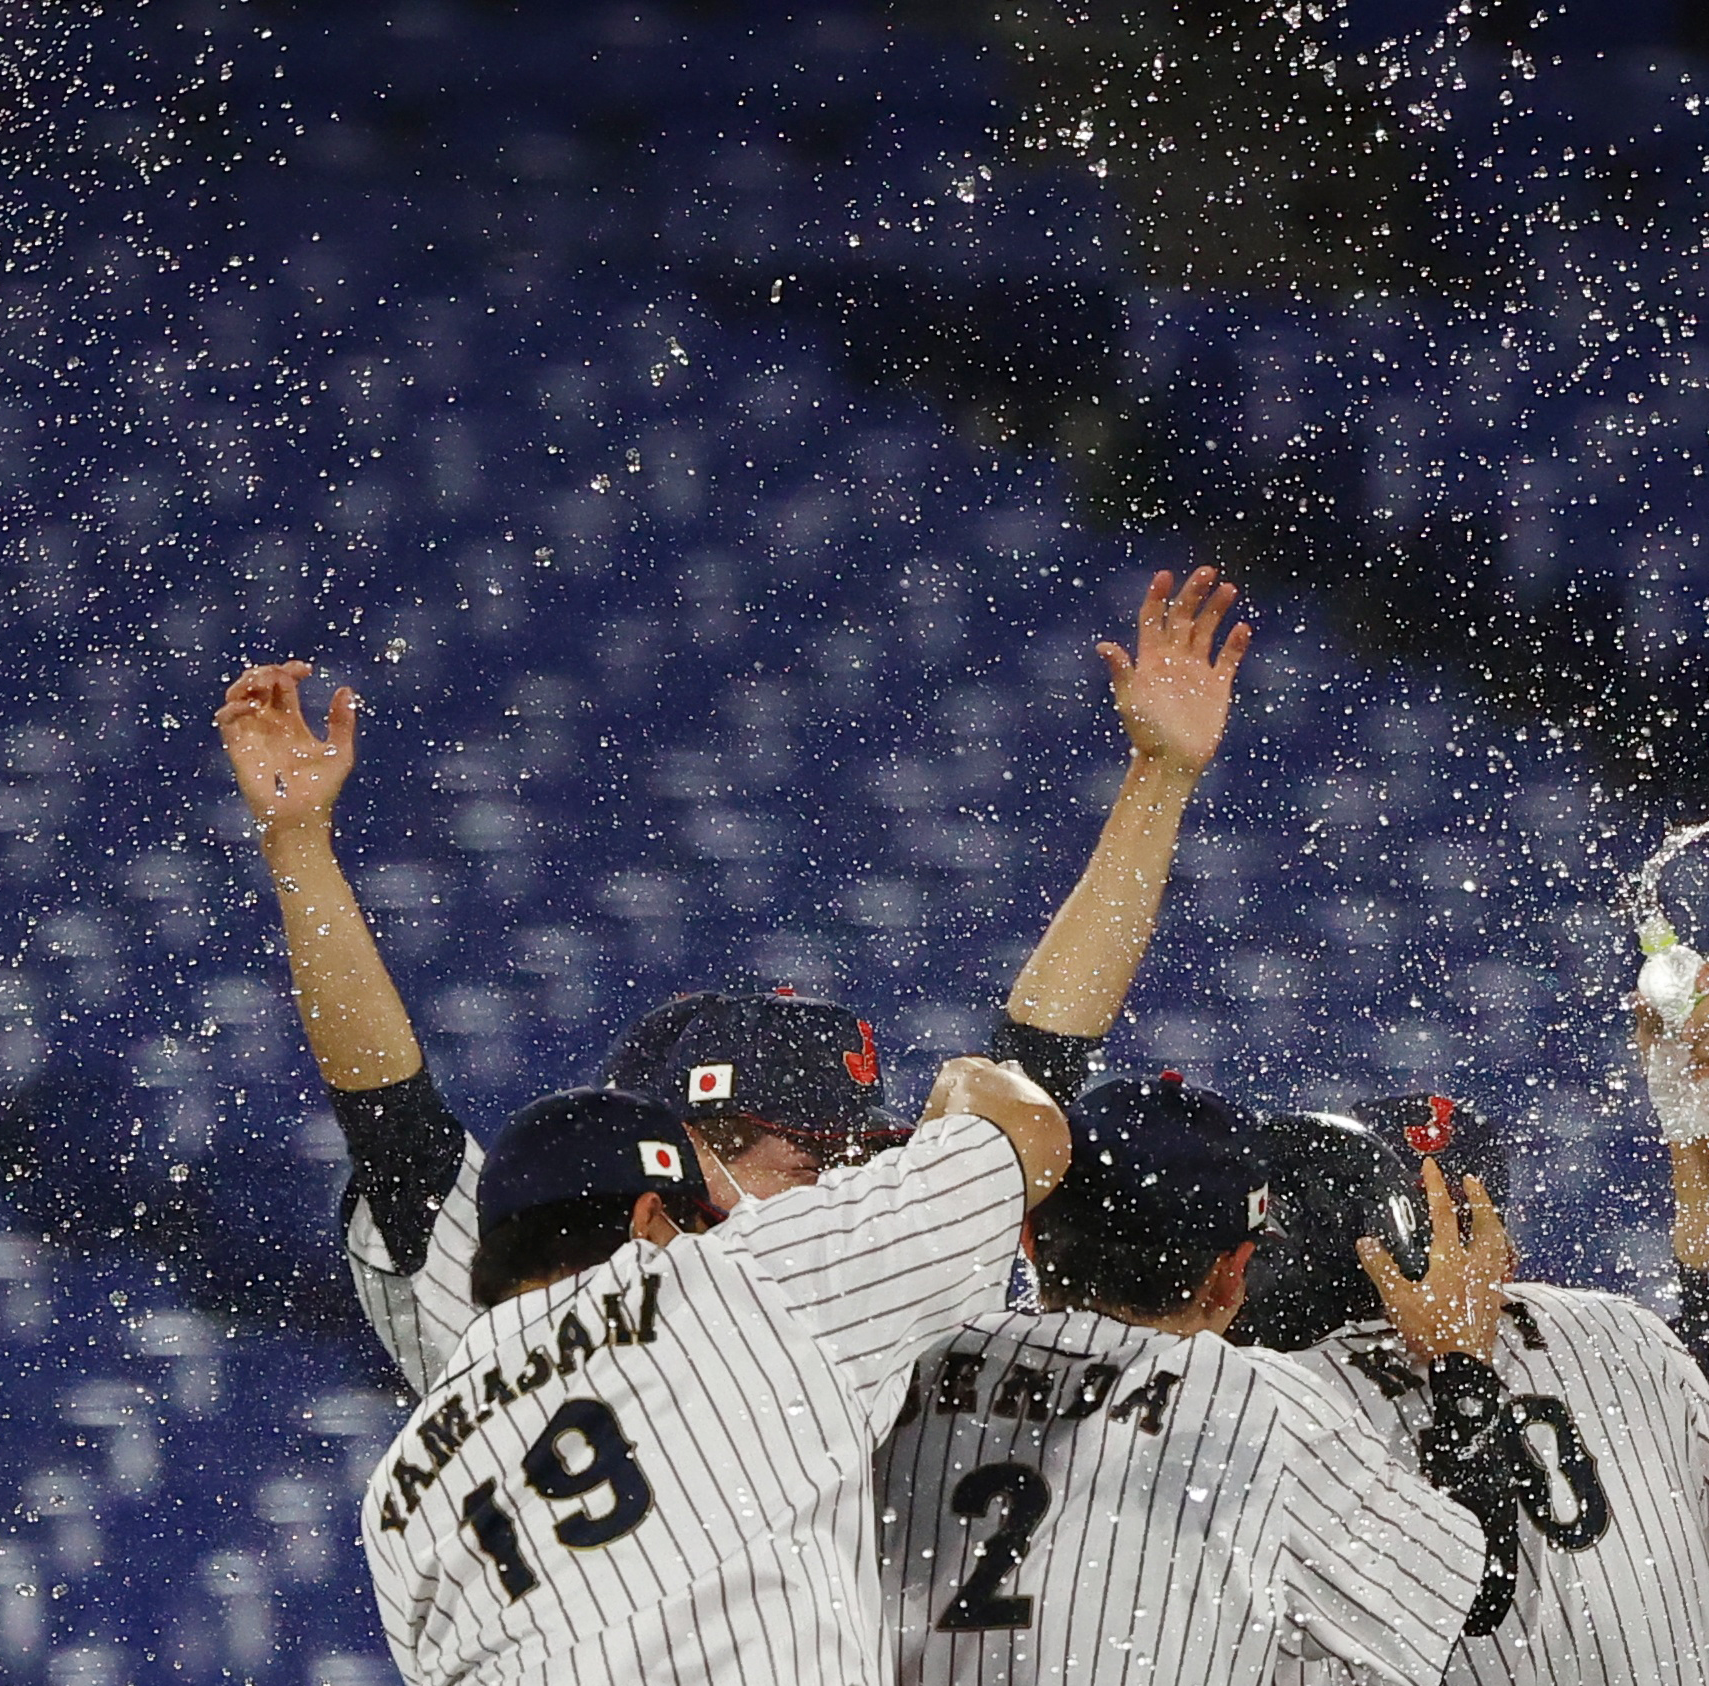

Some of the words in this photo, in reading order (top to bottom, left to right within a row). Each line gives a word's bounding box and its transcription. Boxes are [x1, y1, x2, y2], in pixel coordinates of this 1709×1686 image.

[457, 1395, 656, 1606] 19
[933, 1460, 1054, 1634] 2
[1492, 1393, 1612, 1553] 0
